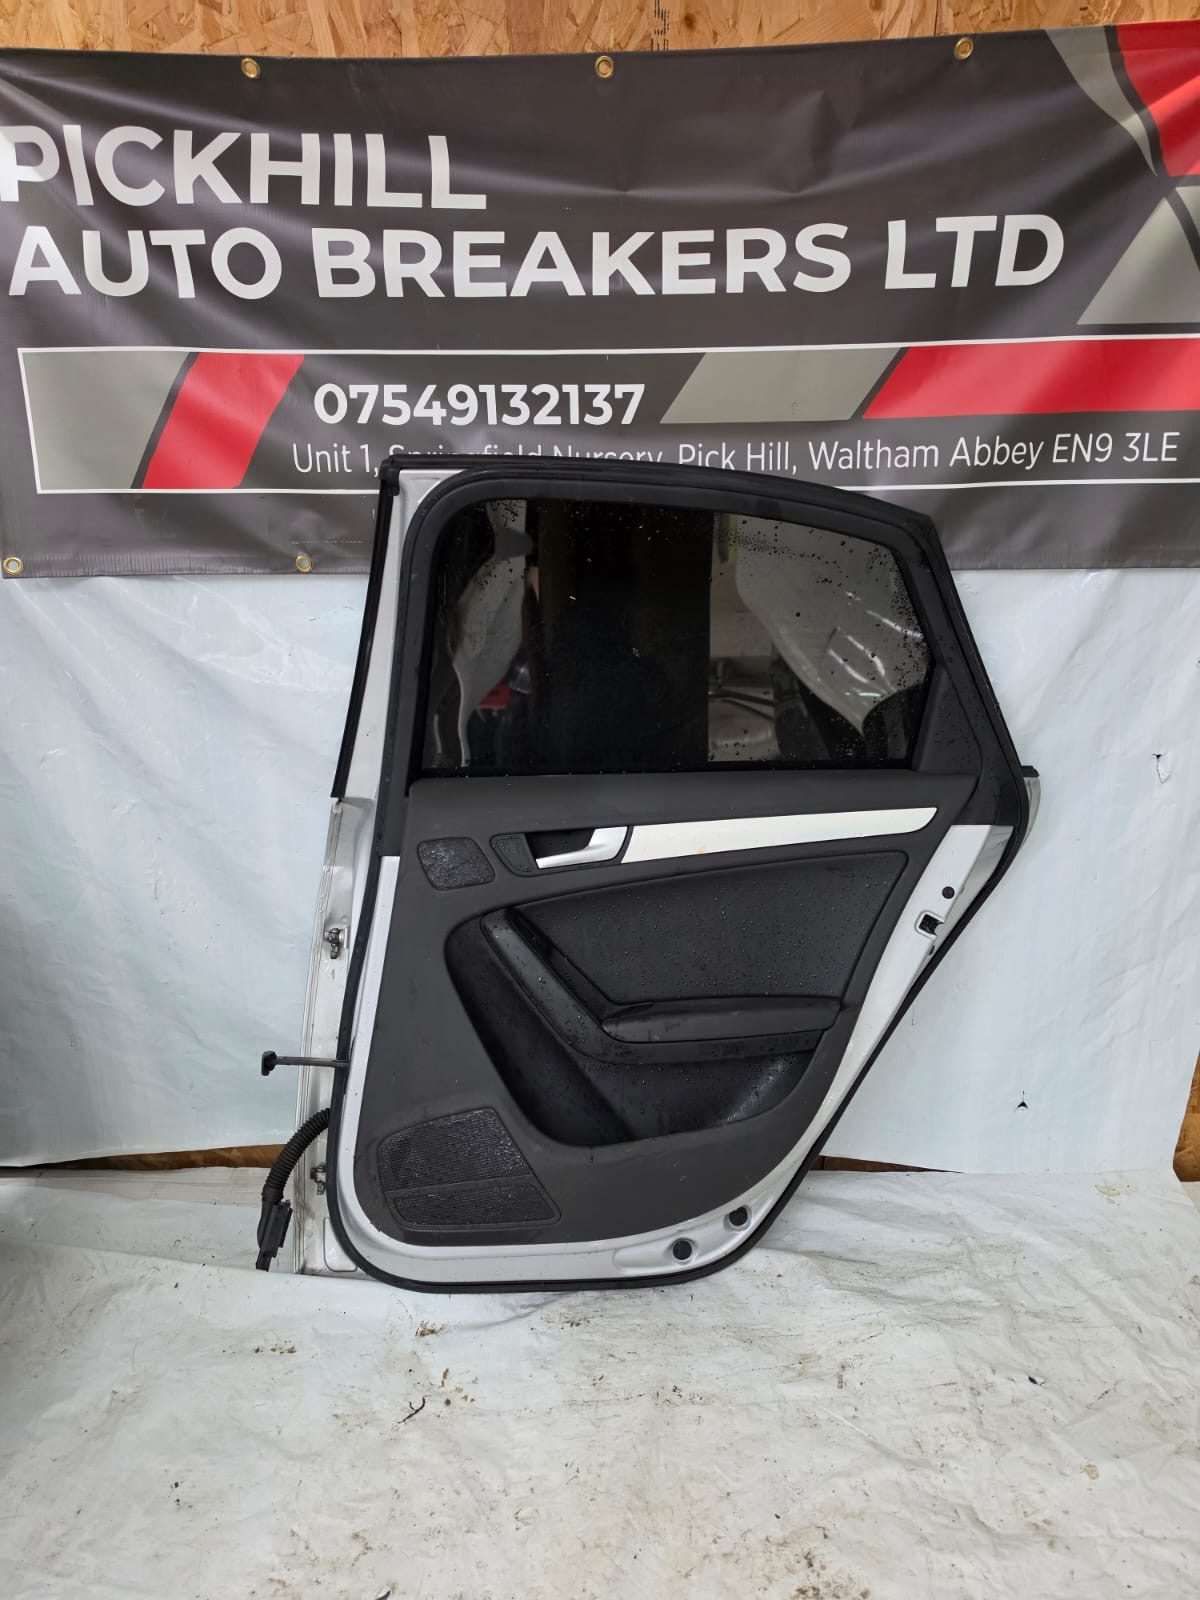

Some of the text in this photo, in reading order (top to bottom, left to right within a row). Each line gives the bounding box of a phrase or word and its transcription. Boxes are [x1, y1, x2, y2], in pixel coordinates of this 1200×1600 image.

[0, 124, 486, 210] PICKHILL
[8, 214, 1065, 300] AUTO BREAKERS LTD
[313, 382, 645, 426] 07549132137
[292, 442, 352, 473] Unit
[359, 443, 379, 477] 1,
[678, 441, 736, 471] Pick
[746, 440, 797, 475] Hill,
[808, 439, 940, 471] Waltham
[948, 435, 1044, 470] Abbey
[1052, 432, 1113, 463] EN9
[1122, 431, 1181, 463] 3LE
